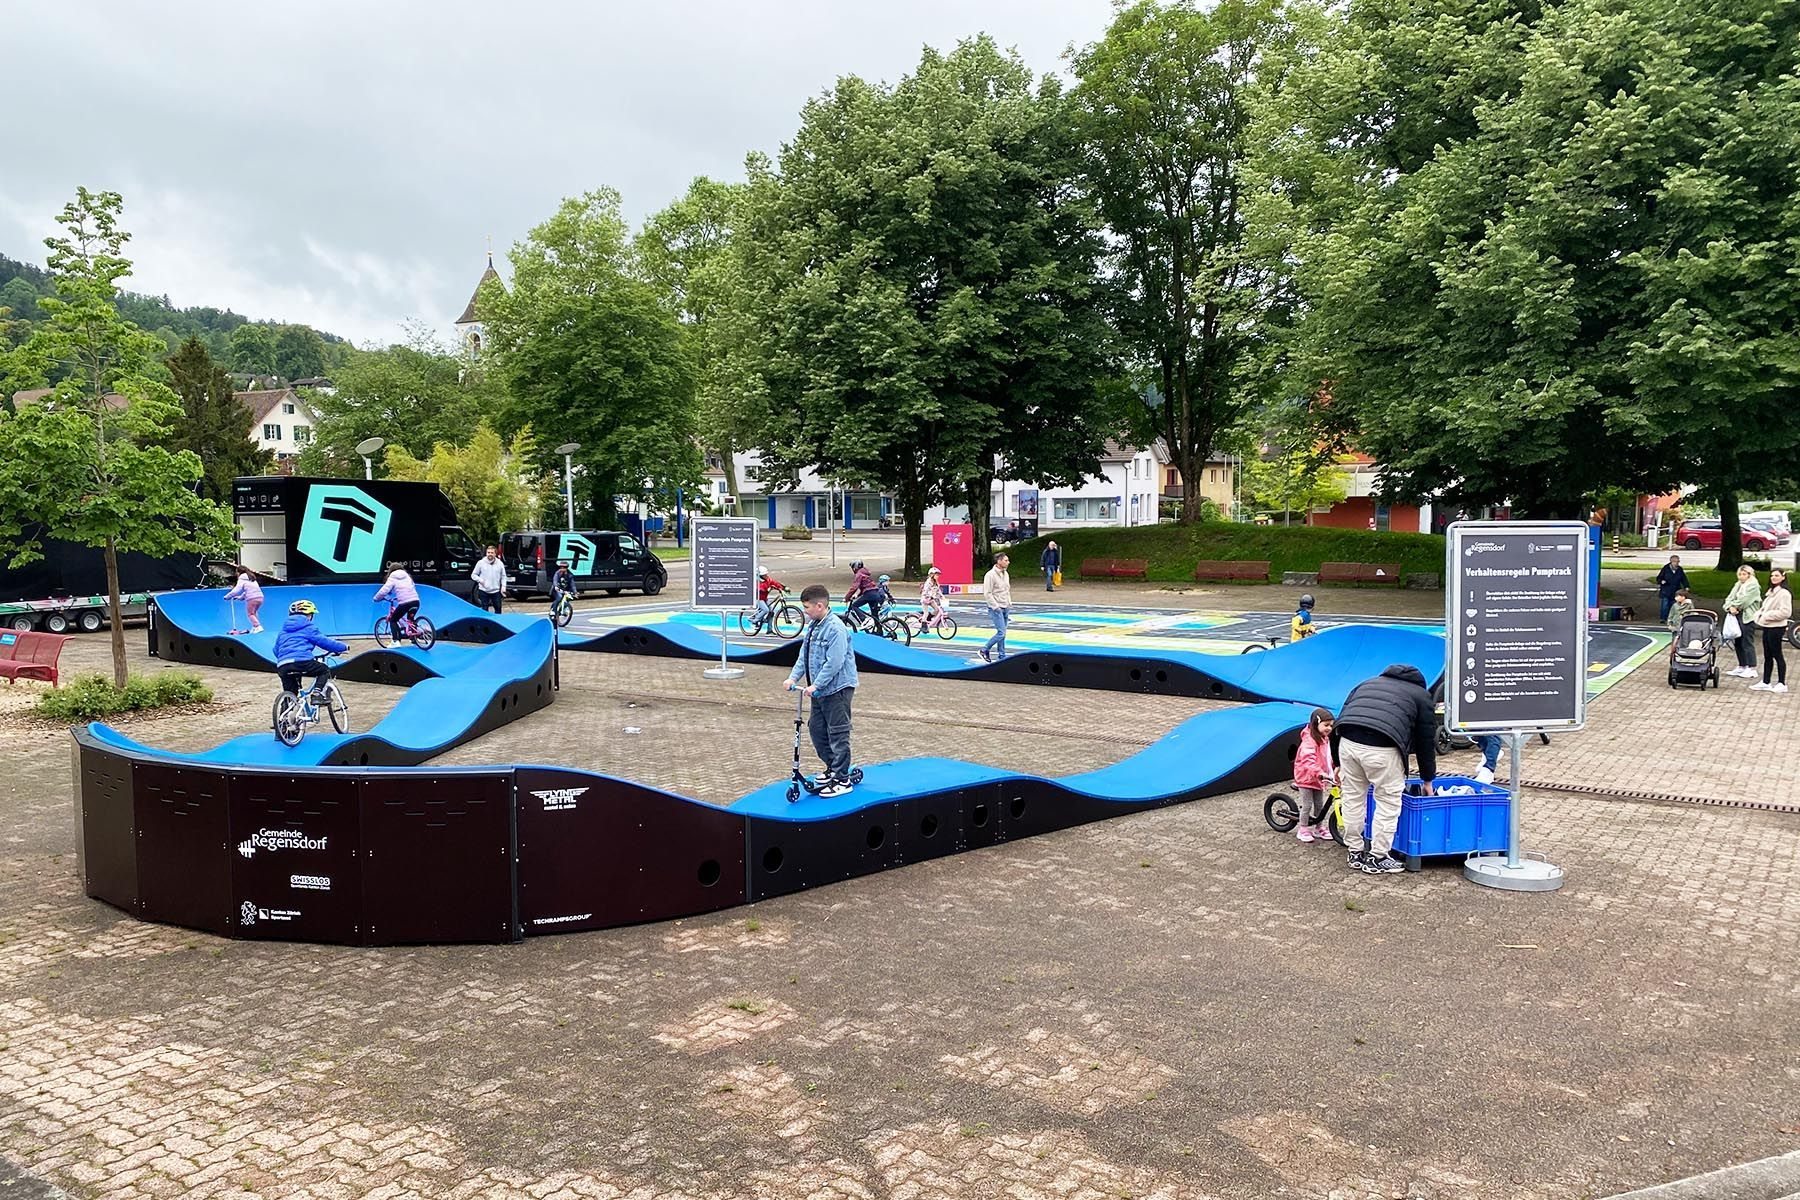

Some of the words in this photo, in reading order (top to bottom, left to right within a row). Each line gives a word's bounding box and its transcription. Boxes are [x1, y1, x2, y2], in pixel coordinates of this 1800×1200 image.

[1465, 567, 1530, 578] Verhaltensregeln
[1531, 567, 1572, 578] Pumptrack
[544, 796, 576, 805] METAL
[259, 828, 302, 838] Gemeinde
[251, 834, 328, 851] Regensdorf
[291, 875, 330, 886] SWISSLOS
